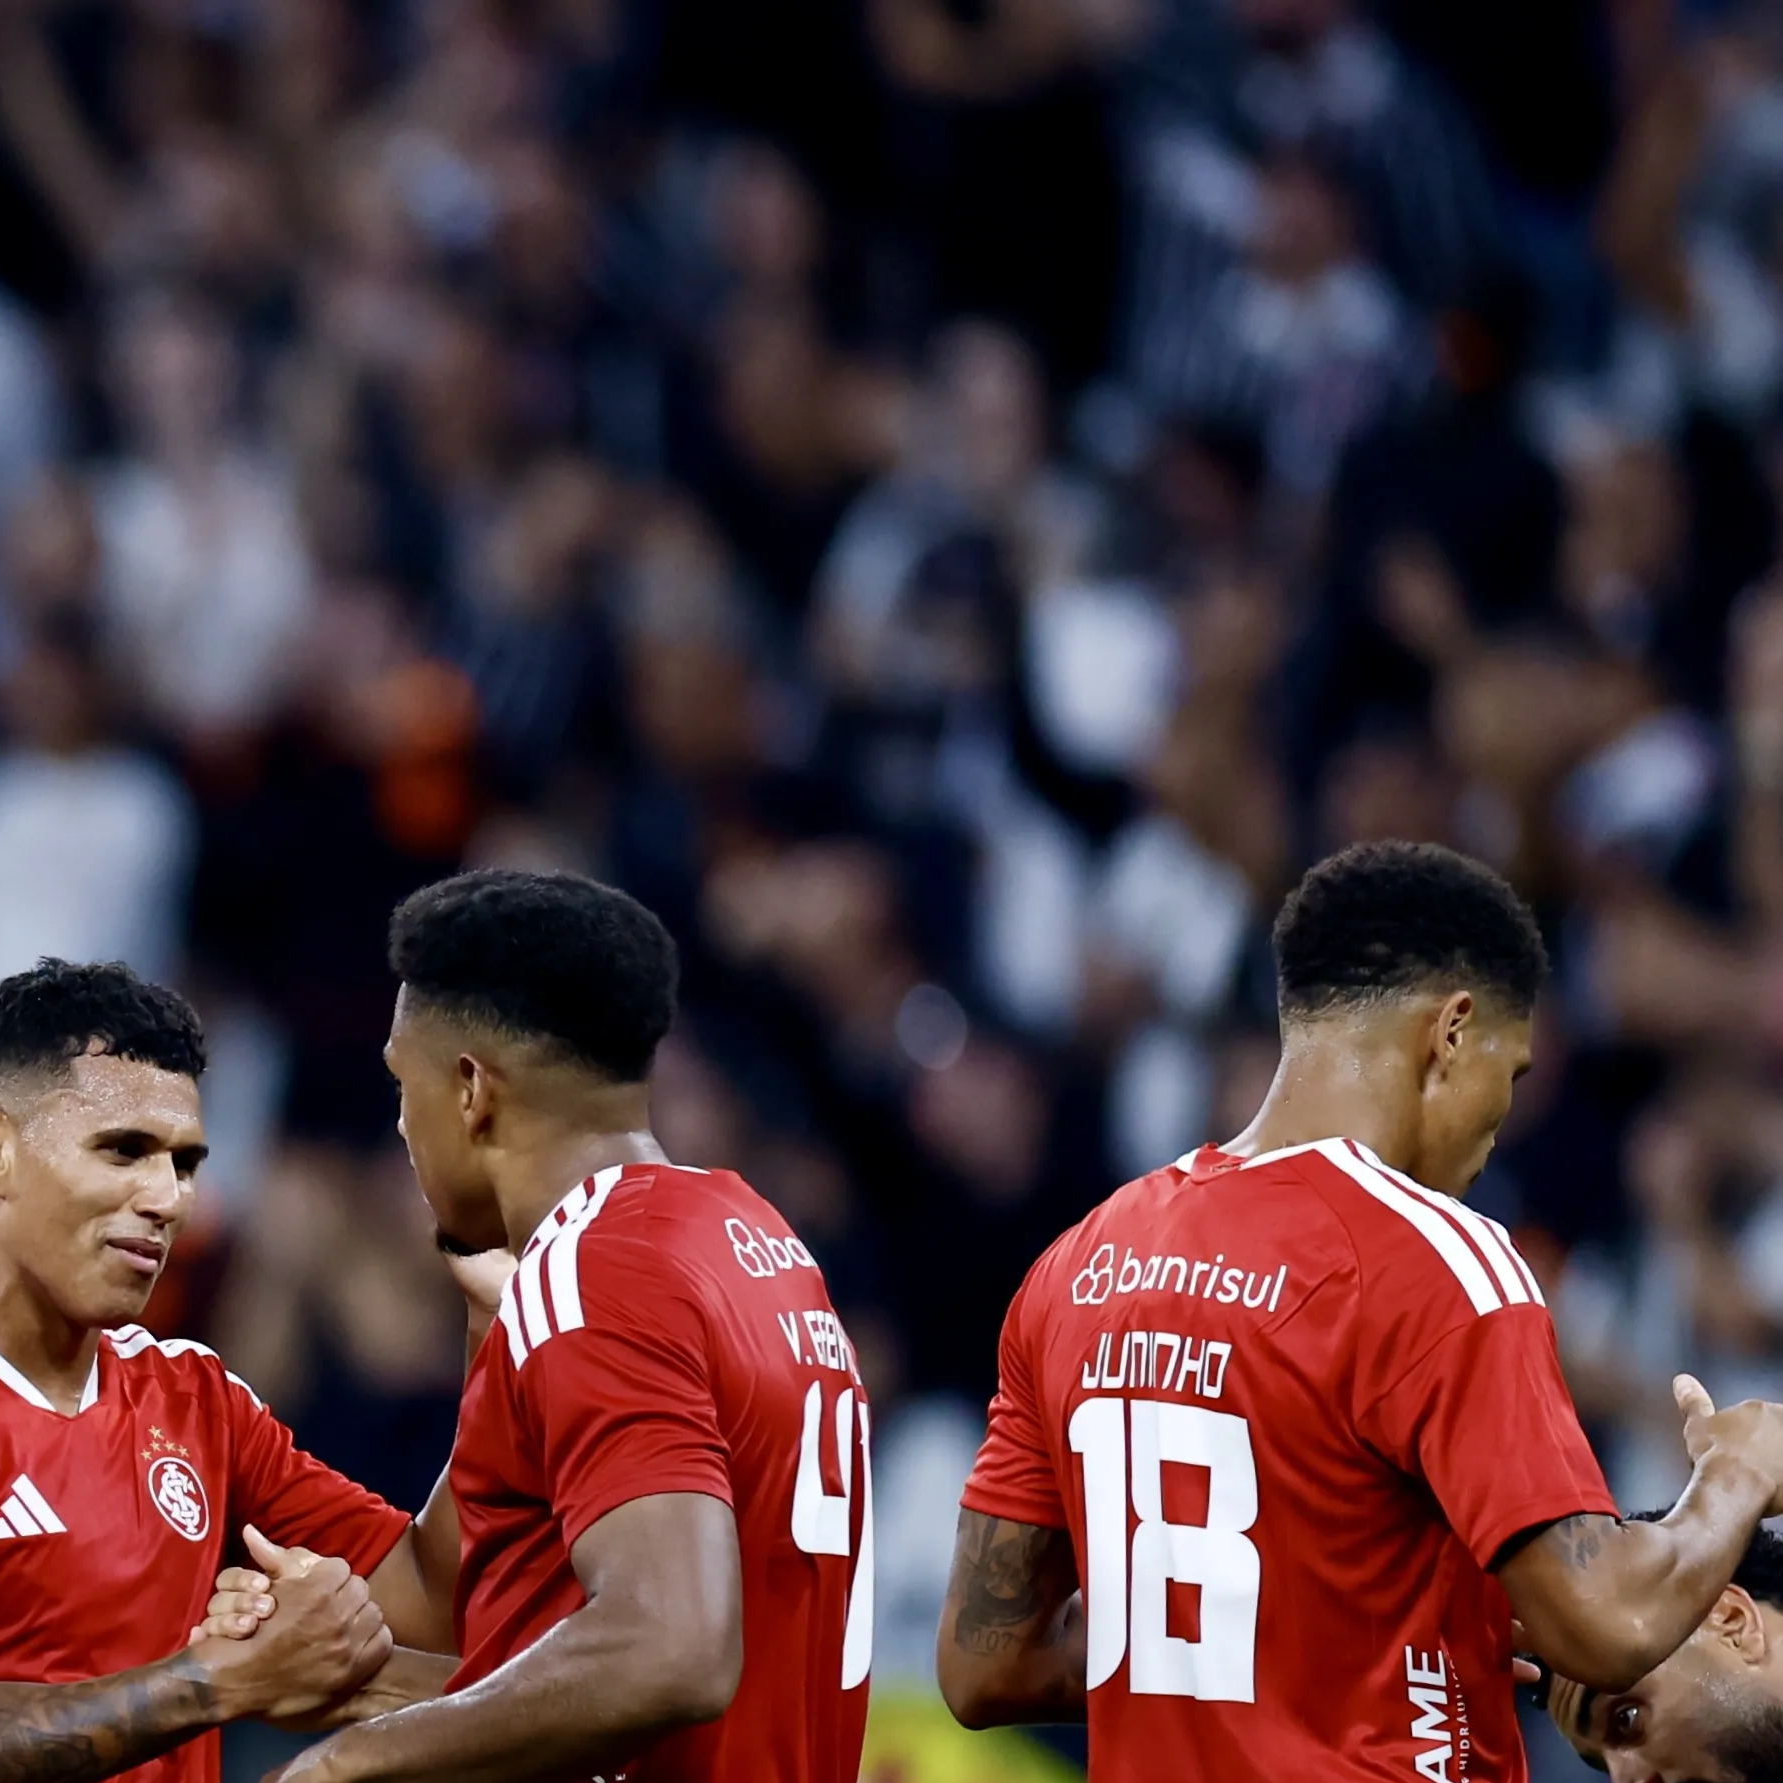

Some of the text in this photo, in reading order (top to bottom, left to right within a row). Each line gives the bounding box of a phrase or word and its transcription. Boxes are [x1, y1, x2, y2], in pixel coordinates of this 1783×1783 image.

[1116, 1247, 1287, 1313] banrisul
[1082, 1331, 1232, 1399] JUNINHO
[1068, 1397, 1261, 1703] 18
